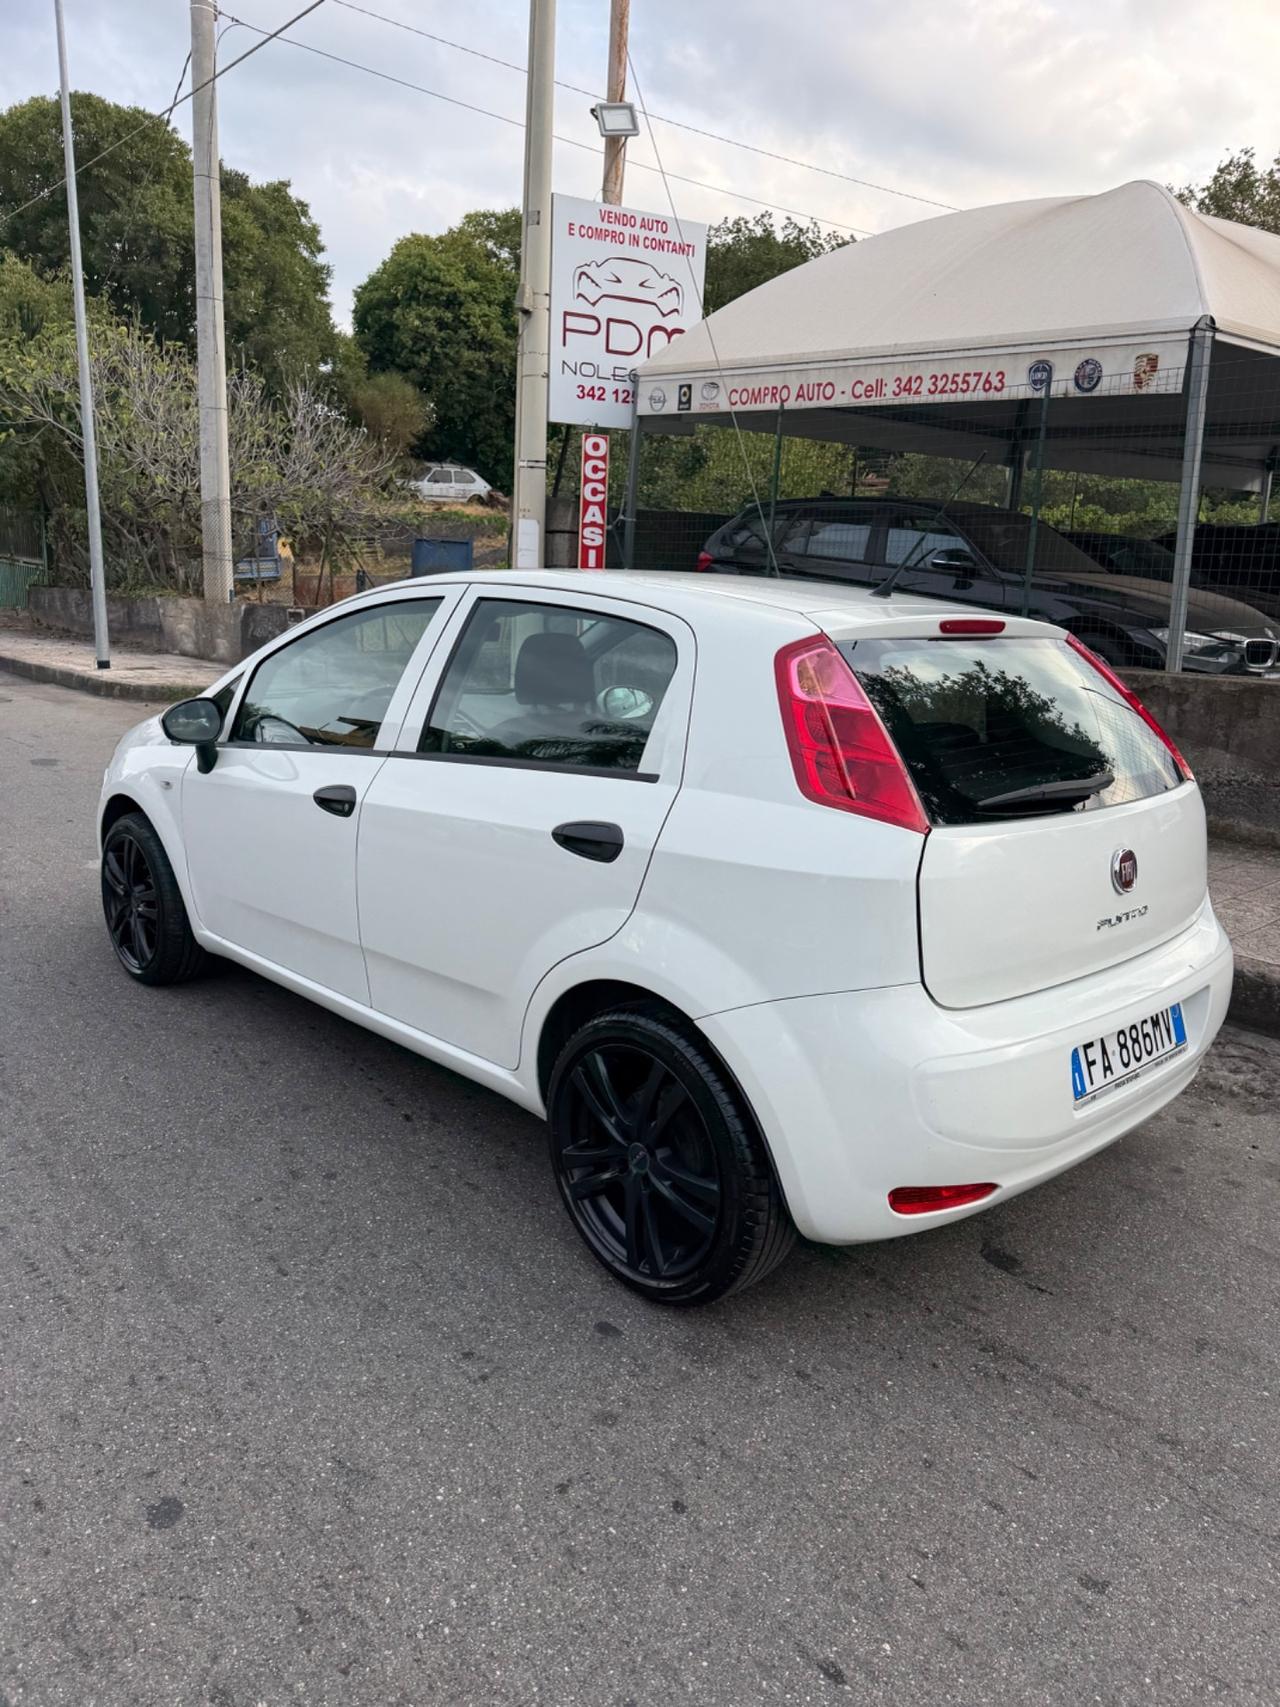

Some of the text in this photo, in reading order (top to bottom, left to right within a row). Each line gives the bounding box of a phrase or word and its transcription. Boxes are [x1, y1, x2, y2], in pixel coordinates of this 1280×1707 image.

[599, 208, 669, 234] VENDO AUTO
[568, 222, 696, 257] E COMPRO IN CONTANTI
[576, 384, 606, 401] 342
[728, 384, 791, 406] COMPRO
[795, 381, 836, 402] AUTO
[851, 378, 888, 399] Cell:
[892, 375, 923, 397] 342
[928, 371, 1006, 395] 3255763
[1082, 1008, 1173, 1086] FA 886MV
